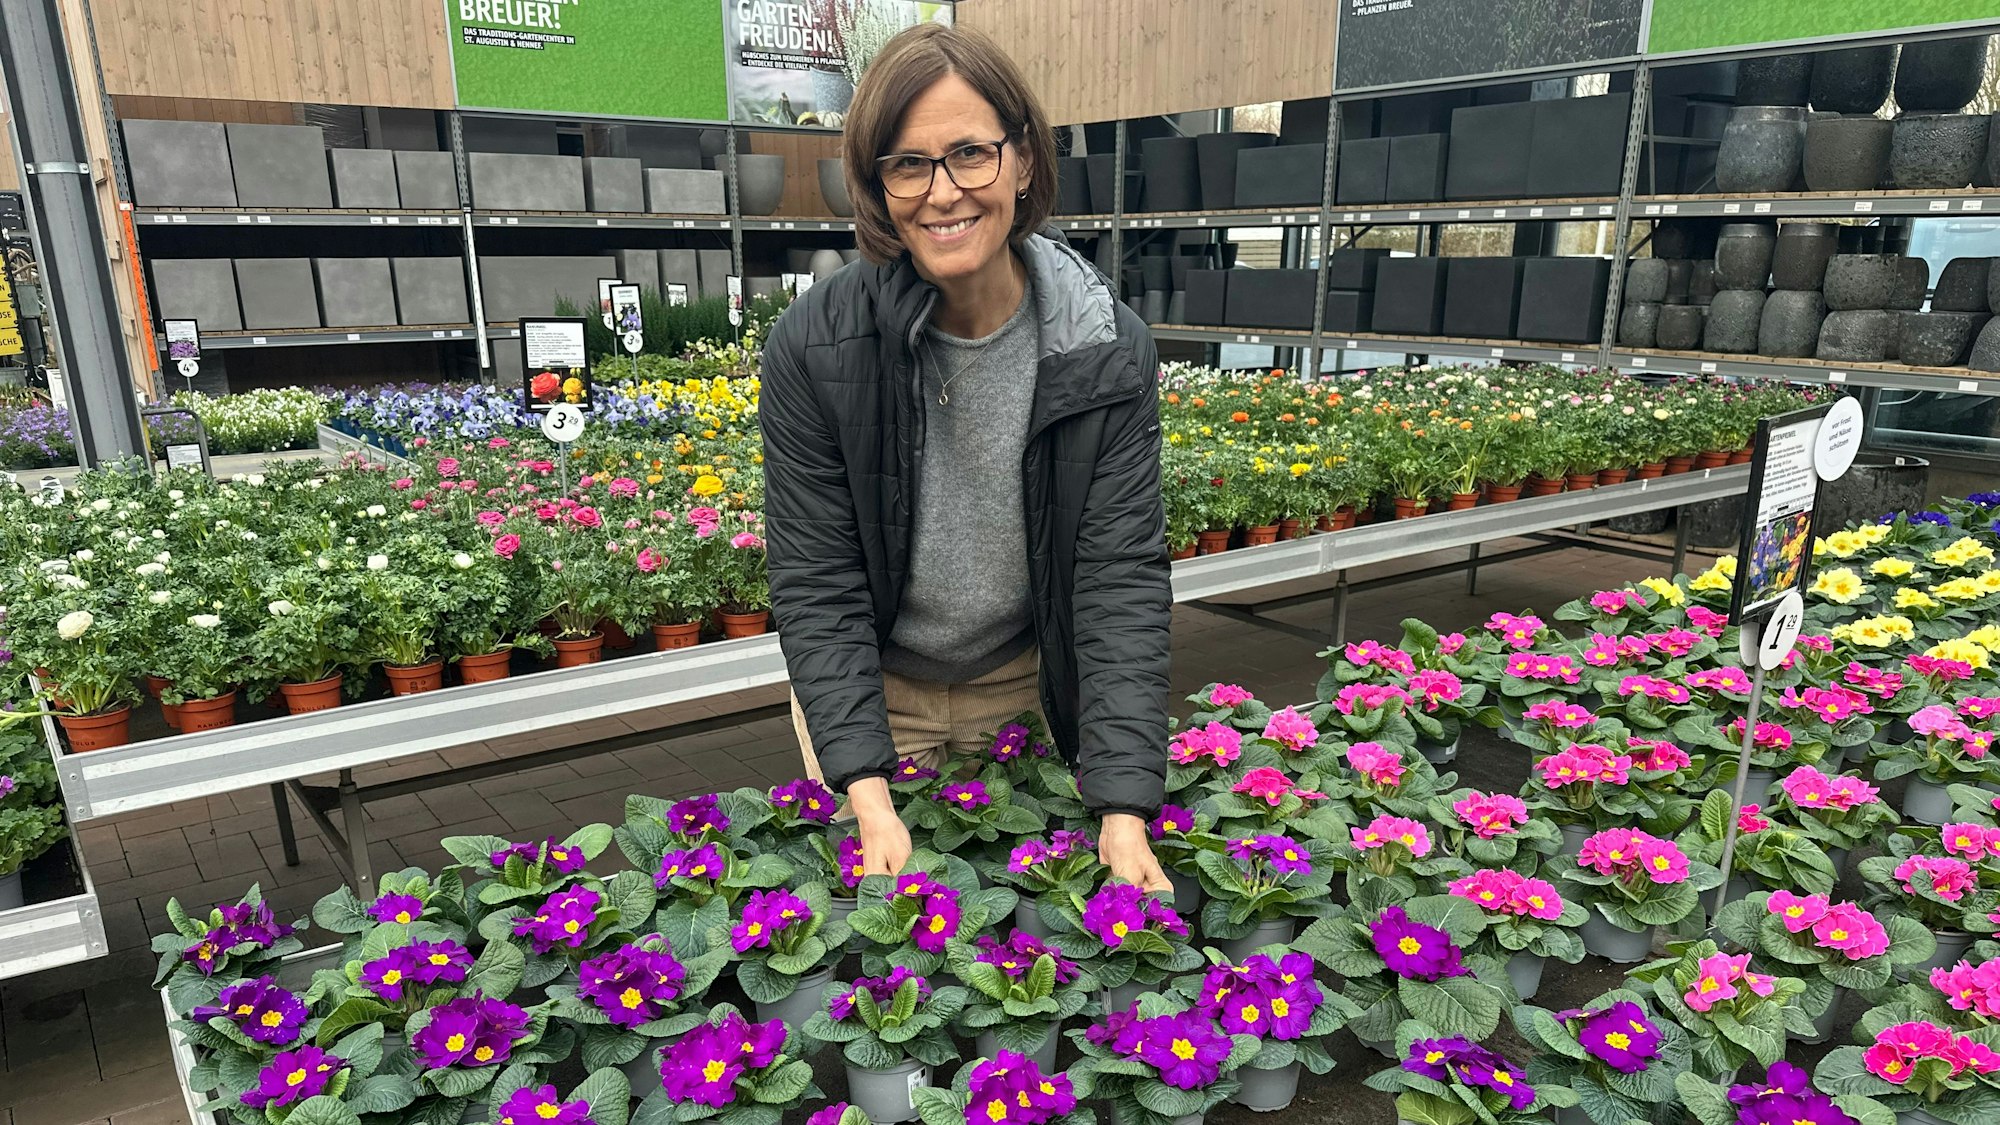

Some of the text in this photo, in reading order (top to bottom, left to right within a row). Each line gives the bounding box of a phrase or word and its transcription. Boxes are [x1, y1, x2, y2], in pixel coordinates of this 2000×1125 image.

[459, 0, 562, 30] BREUER!
[737, 0, 821, 29] GARTEN-
[1357, 4, 1387, 17] PFLANZEN
[1388, 0, 1414, 11] BREUER.
[463, 27, 575, 44] DAS TRADITIONS-GARTENCENTER IN
[464, 36, 544, 50] ST. AUGUSTIN & HENNEF.
[739, 22, 835, 53] FREUDEN!
[741, 51, 770, 61] HÜBSCHES
[770, 53, 782, 61] ZUM
[782, 54, 815, 64] DEKORIEREN
[820, 58, 847, 66] PFLANZEN
[747, 60, 775, 69] ENTDECKE
[627, 334, 635, 345] 3
[552, 411, 567, 430] 3
[1768, 614, 1798, 650] 1 29
